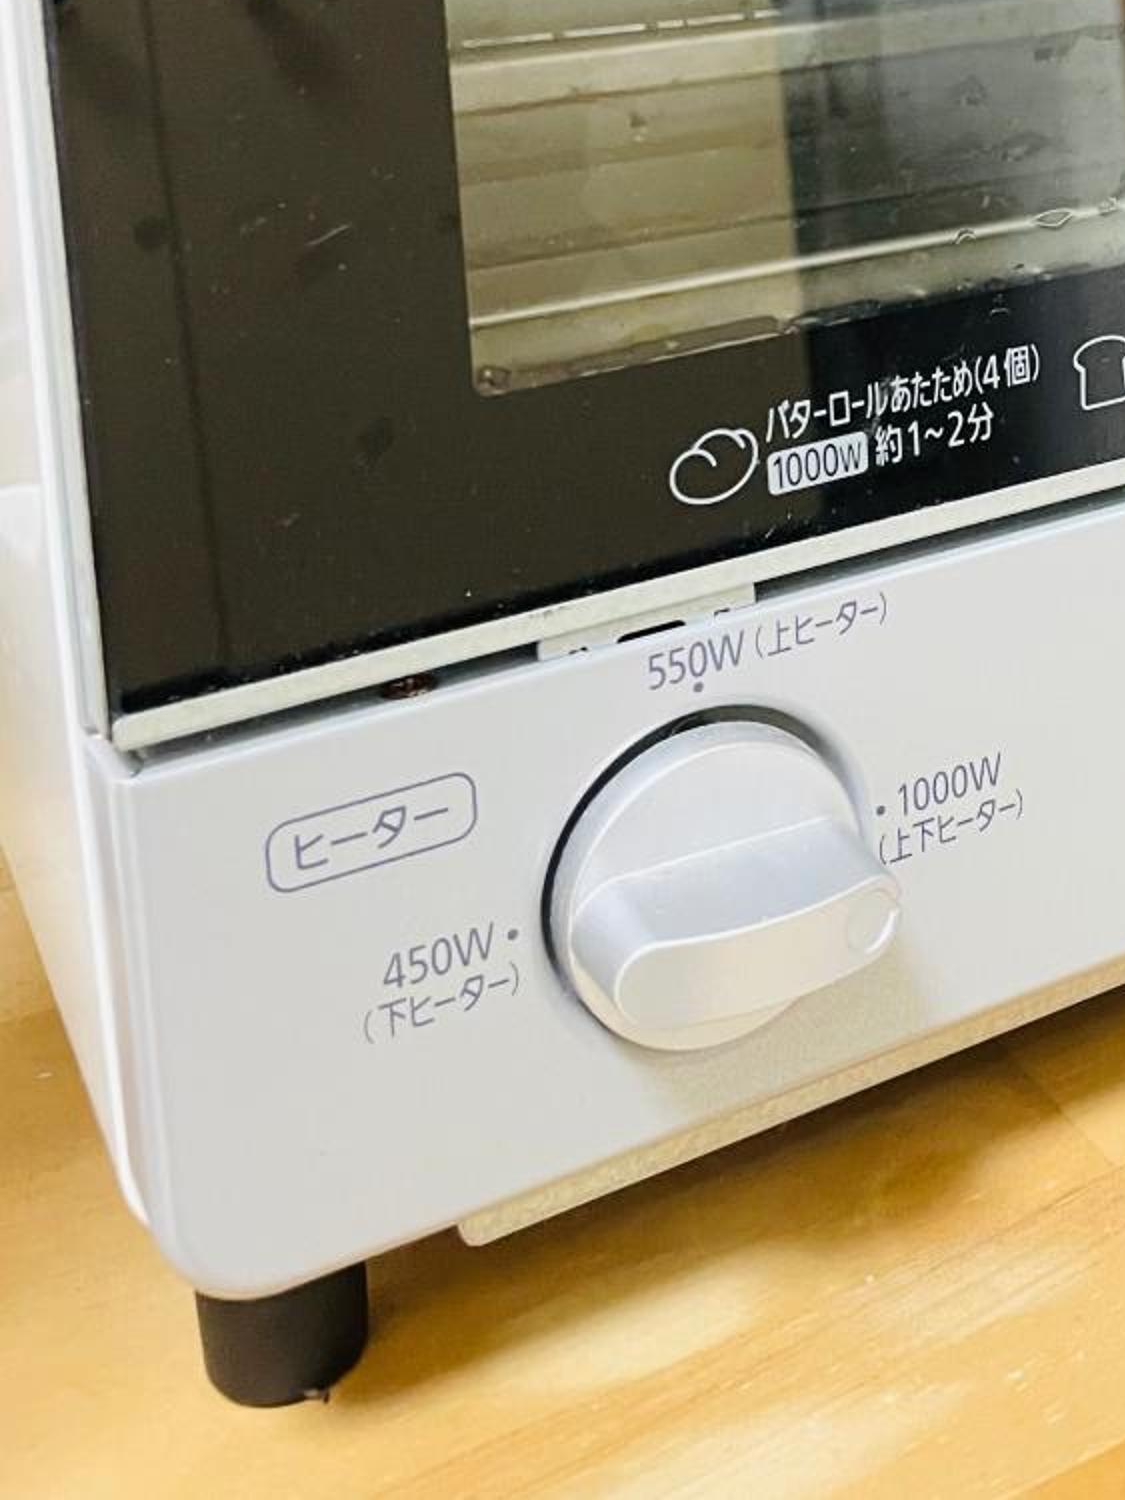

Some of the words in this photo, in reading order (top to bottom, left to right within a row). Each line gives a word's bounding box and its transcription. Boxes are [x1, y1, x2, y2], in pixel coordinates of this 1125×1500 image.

[773, 443, 862, 491] 1000W
[648, 628, 745, 691] 550W
[898, 752, 1002, 816] 1000W
[294, 804, 449, 871] ヒーター
[879, 788, 1024, 865] (上下ヒーター)
[382, 922, 495, 989] 450W
[363, 960, 519, 1045] (下ヒーター)
